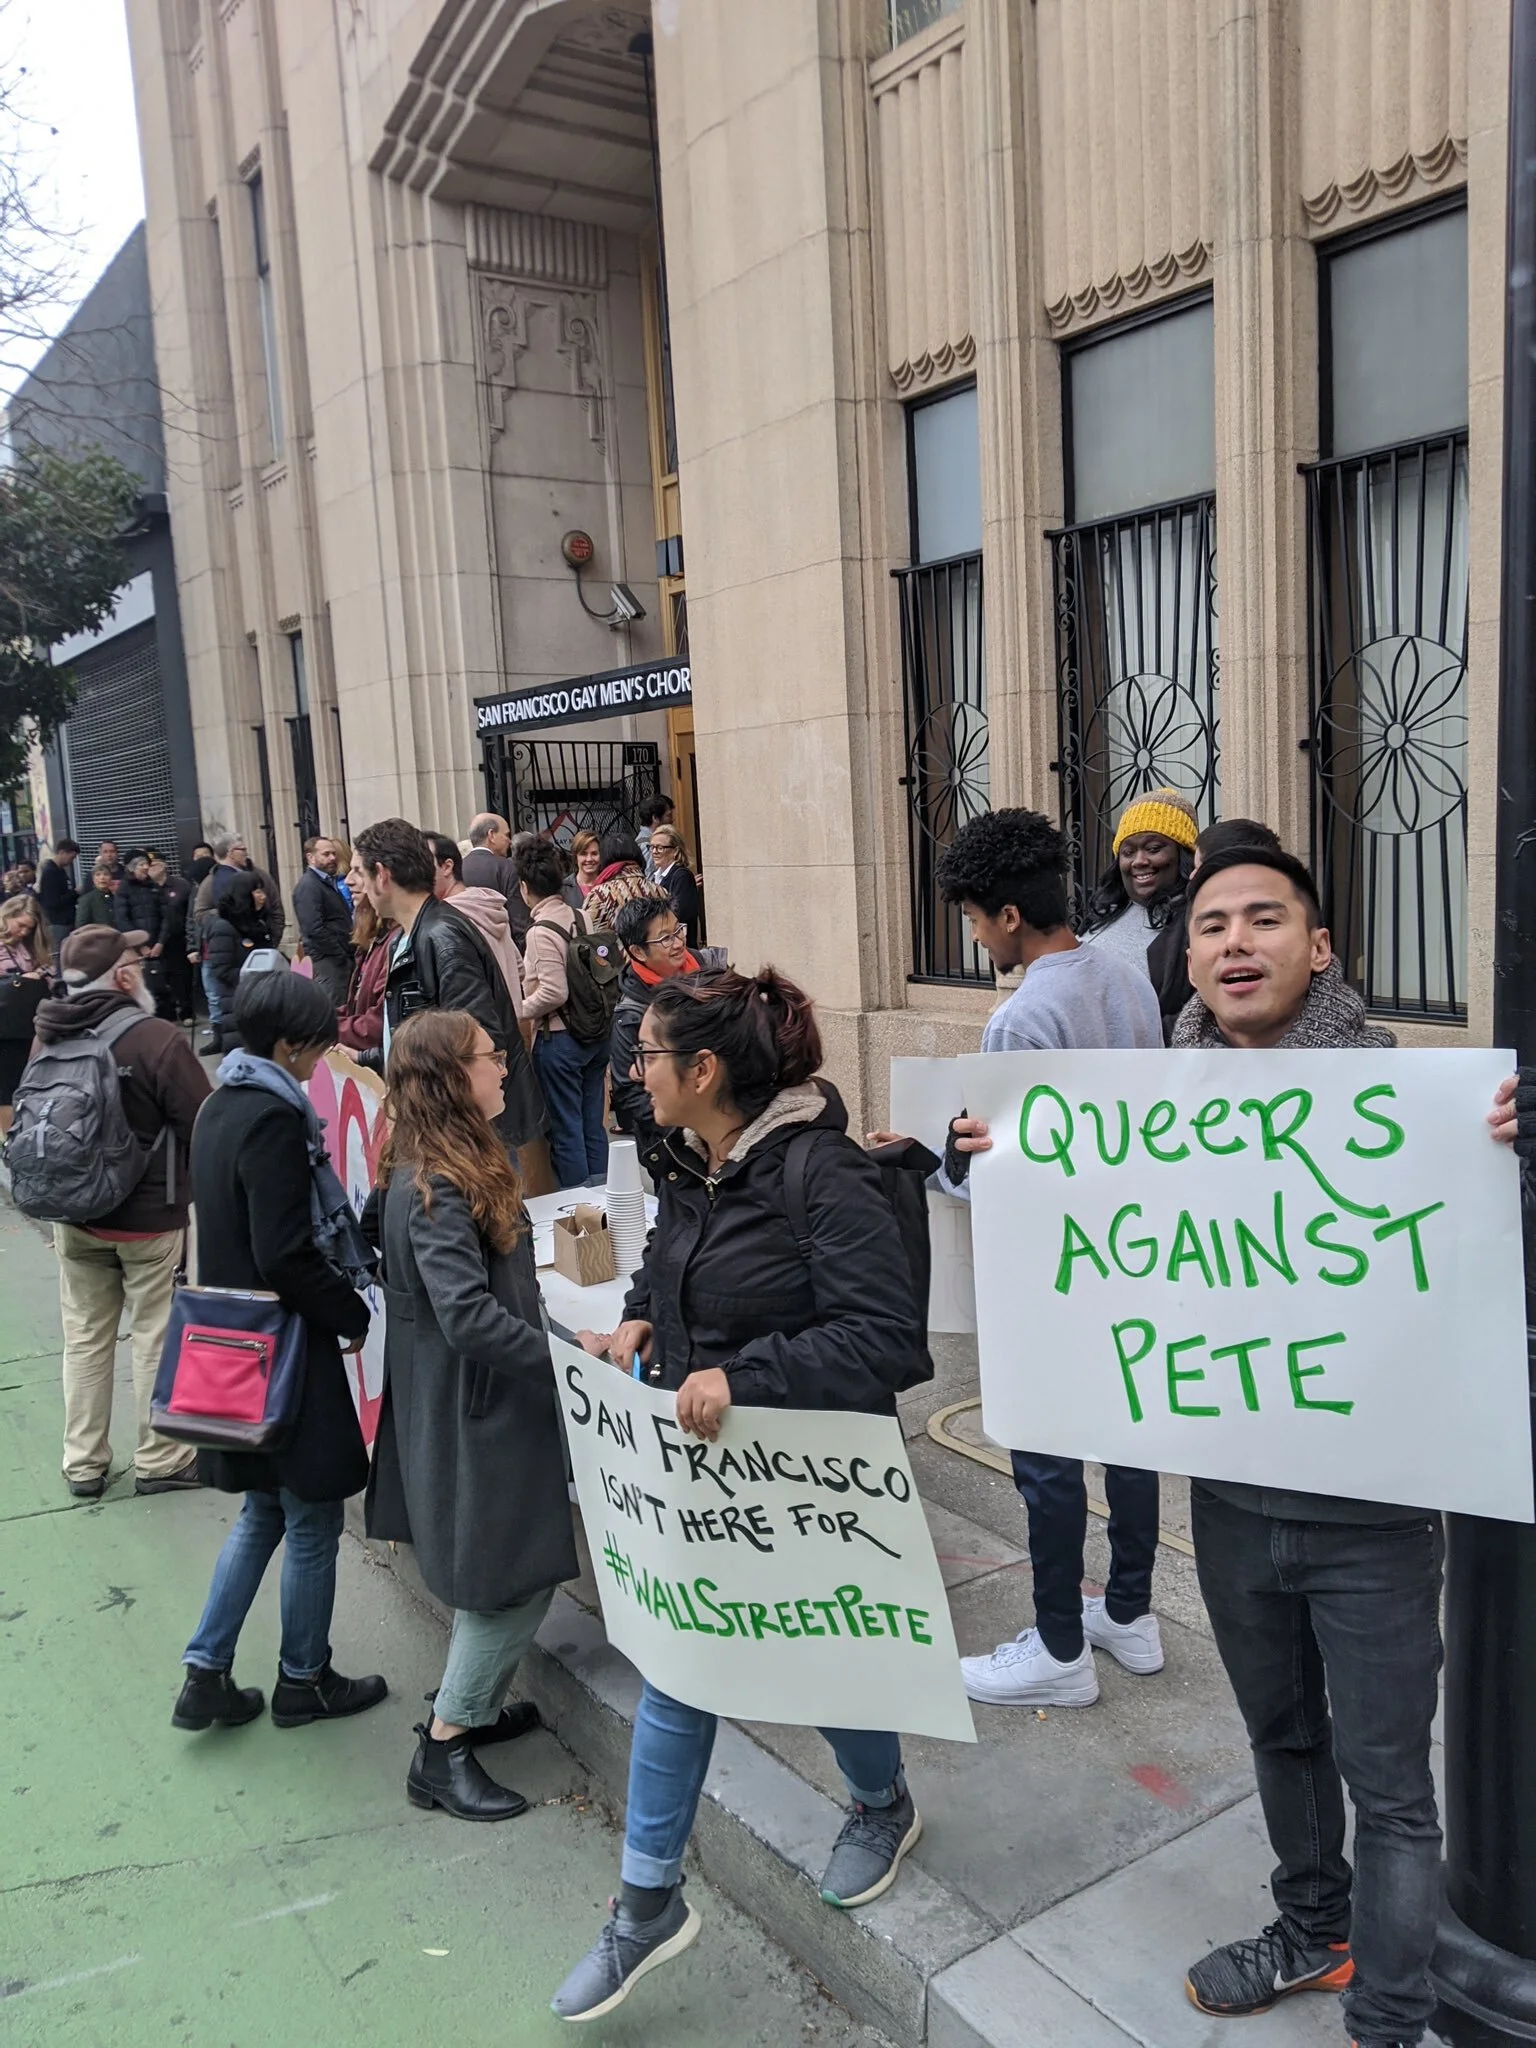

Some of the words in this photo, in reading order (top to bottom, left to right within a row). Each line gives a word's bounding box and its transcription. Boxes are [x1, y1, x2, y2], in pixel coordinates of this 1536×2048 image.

[477, 704, 503, 728] SAN
[501, 690, 570, 724] FRANCISCO
[571, 684, 598, 711] GAY
[599, 675, 645, 706] MEN'S
[632, 747, 649, 762] 170
[1055, 1191, 1445, 1294] AGAINST
[1111, 1319, 1354, 1423] PETE
[566, 1364, 637, 1454] SAN
[651, 1413, 911, 1503] FRANCISCO
[600, 1467, 666, 1535] ISN'T
[677, 1504, 775, 1553] HERE
[787, 1503, 902, 1560] FOR
[603, 1531, 932, 1646] #WALLSTREETPETE
